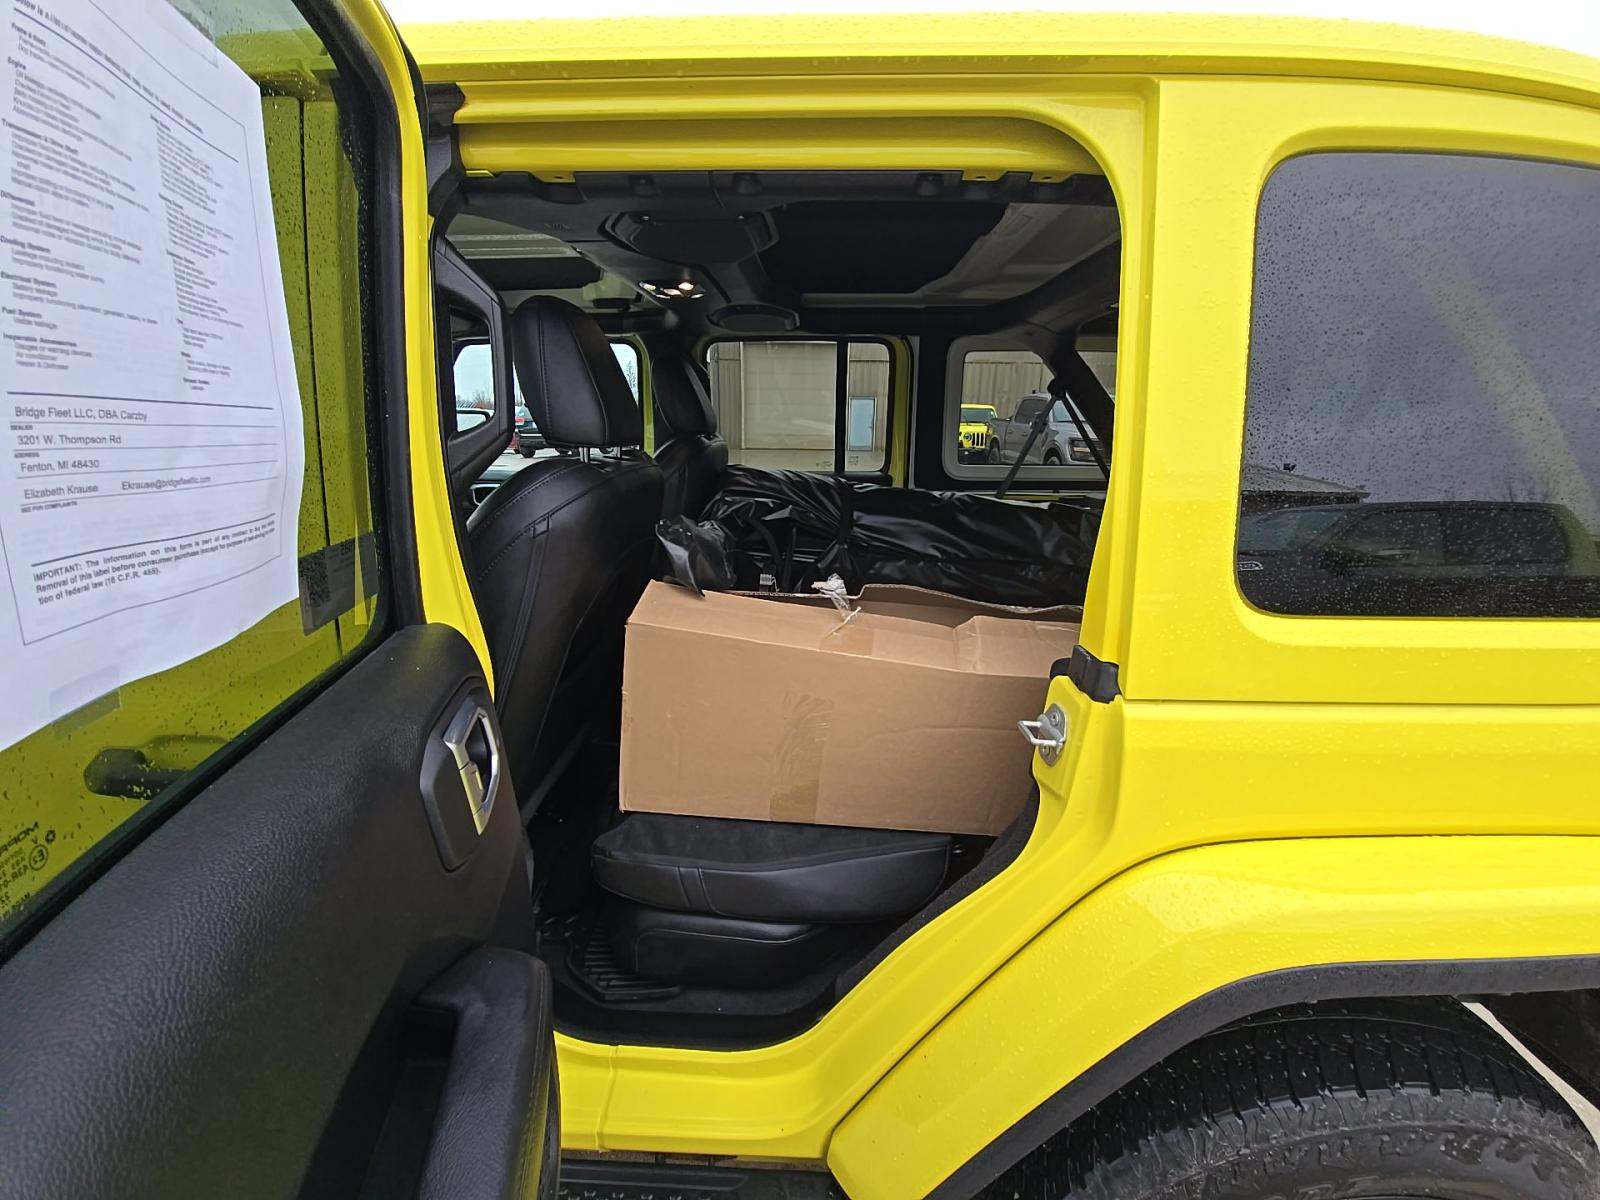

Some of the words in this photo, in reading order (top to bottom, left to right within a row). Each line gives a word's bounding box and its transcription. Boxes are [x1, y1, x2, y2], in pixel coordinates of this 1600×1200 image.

[14, 406, 46, 419] Bridge
[48, 407, 72, 418] Fleet
[74, 408, 96, 419] LLC,
[98, 409, 118, 419] DBA
[17, 435, 40, 445] 3201
[43, 435, 56, 445] W.
[58, 434, 107, 446] Thompson
[109, 435, 122, 444] Rd
[20, 462, 55, 473] Fenton,
[57, 460, 69, 470] MI
[71, 459, 100, 469] 48430
[24, 485, 65, 499] Elizabeth
[66, 484, 99, 495] Krause
[33, 563, 83, 581] IMPORTANT:
[103, 550, 147, 564] information
[150, 548, 160, 556] on
[36, 578, 68, 593] Removal
[70, 575, 78, 584] of
[79, 572, 92, 581] this
[93, 567, 109, 578] label
[112, 562, 136, 573] before
[137, 556, 173, 568] consumer
[38, 595, 53, 605] tion
[55, 592, 64, 601] of
[65, 584, 90, 597] federal
[91, 580, 104, 588] law
